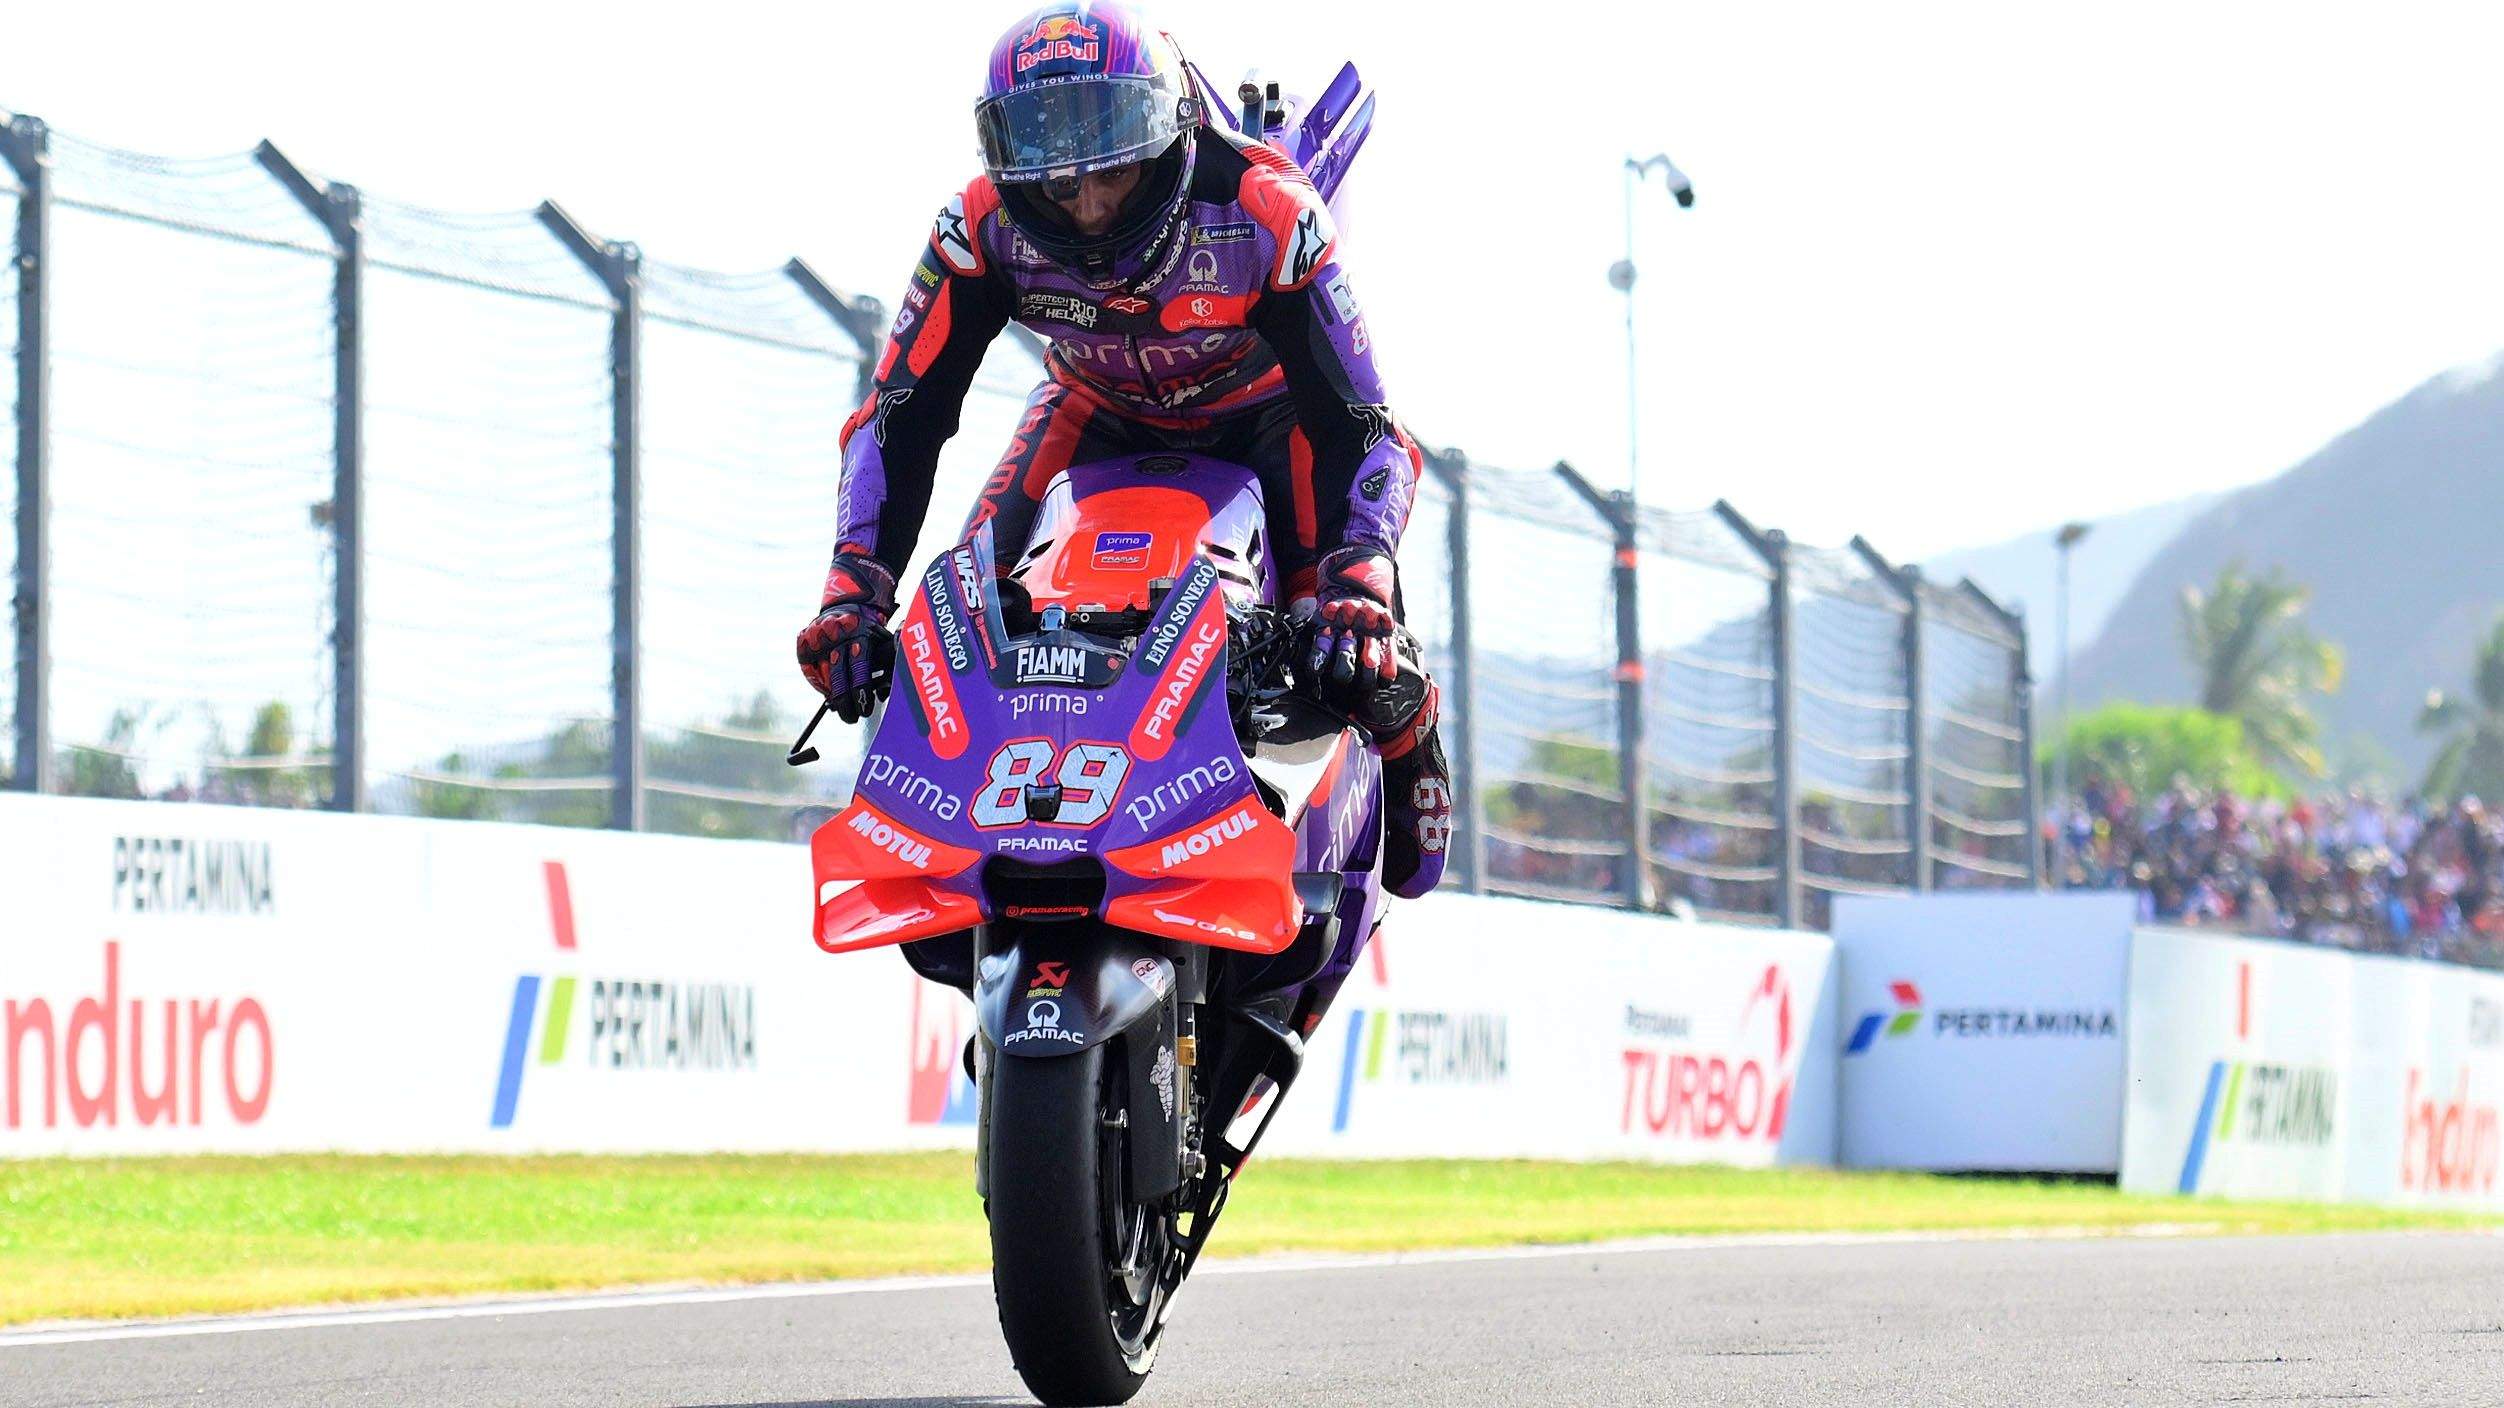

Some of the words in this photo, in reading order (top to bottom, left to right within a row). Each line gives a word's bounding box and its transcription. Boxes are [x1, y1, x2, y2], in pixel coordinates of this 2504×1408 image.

[1017, 41, 1054, 72] Red
[1055, 40, 1099, 61] Bull
[1008, 81, 1036, 94] GIVES
[1042, 76, 1065, 86] YOU
[1070, 73, 1109, 82] WINGS
[1210, 227, 1251, 239] MICHELIN
[1179, 283, 1230, 294] PRAMAC
[1045, 308, 1098, 328] HELMET
[1106, 537, 1140, 546] prima
[926, 568, 948, 605] LINO
[954, 549, 983, 609] WRS
[1170, 564, 1216, 626] SONEGO
[936, 604, 968, 670] SONEGO
[906, 622, 958, 738] PRAMAC
[1016, 647, 1086, 677] FIAMM
[1144, 624, 1220, 740] PRAMAC
[1010, 694, 1087, 719] prima
[864, 754, 962, 821] prima
[972, 741, 1130, 825] 89
[1125, 755, 1236, 832] prima
[848, 811, 933, 870] MOTUL
[997, 838, 1088, 852] PRAMAC
[1161, 809, 1258, 869] MOTUL
[113, 837, 274, 913] PERTAMINA
[1019, 905, 1090, 916] pramacracing
[591, 980, 758, 1068] PERTAMINA
[1004, 1028, 1085, 1047] PRAMAC
[1935, 1010, 2118, 1037] PERTAMINA
[1619, 1051, 1764, 1138] TURBO
